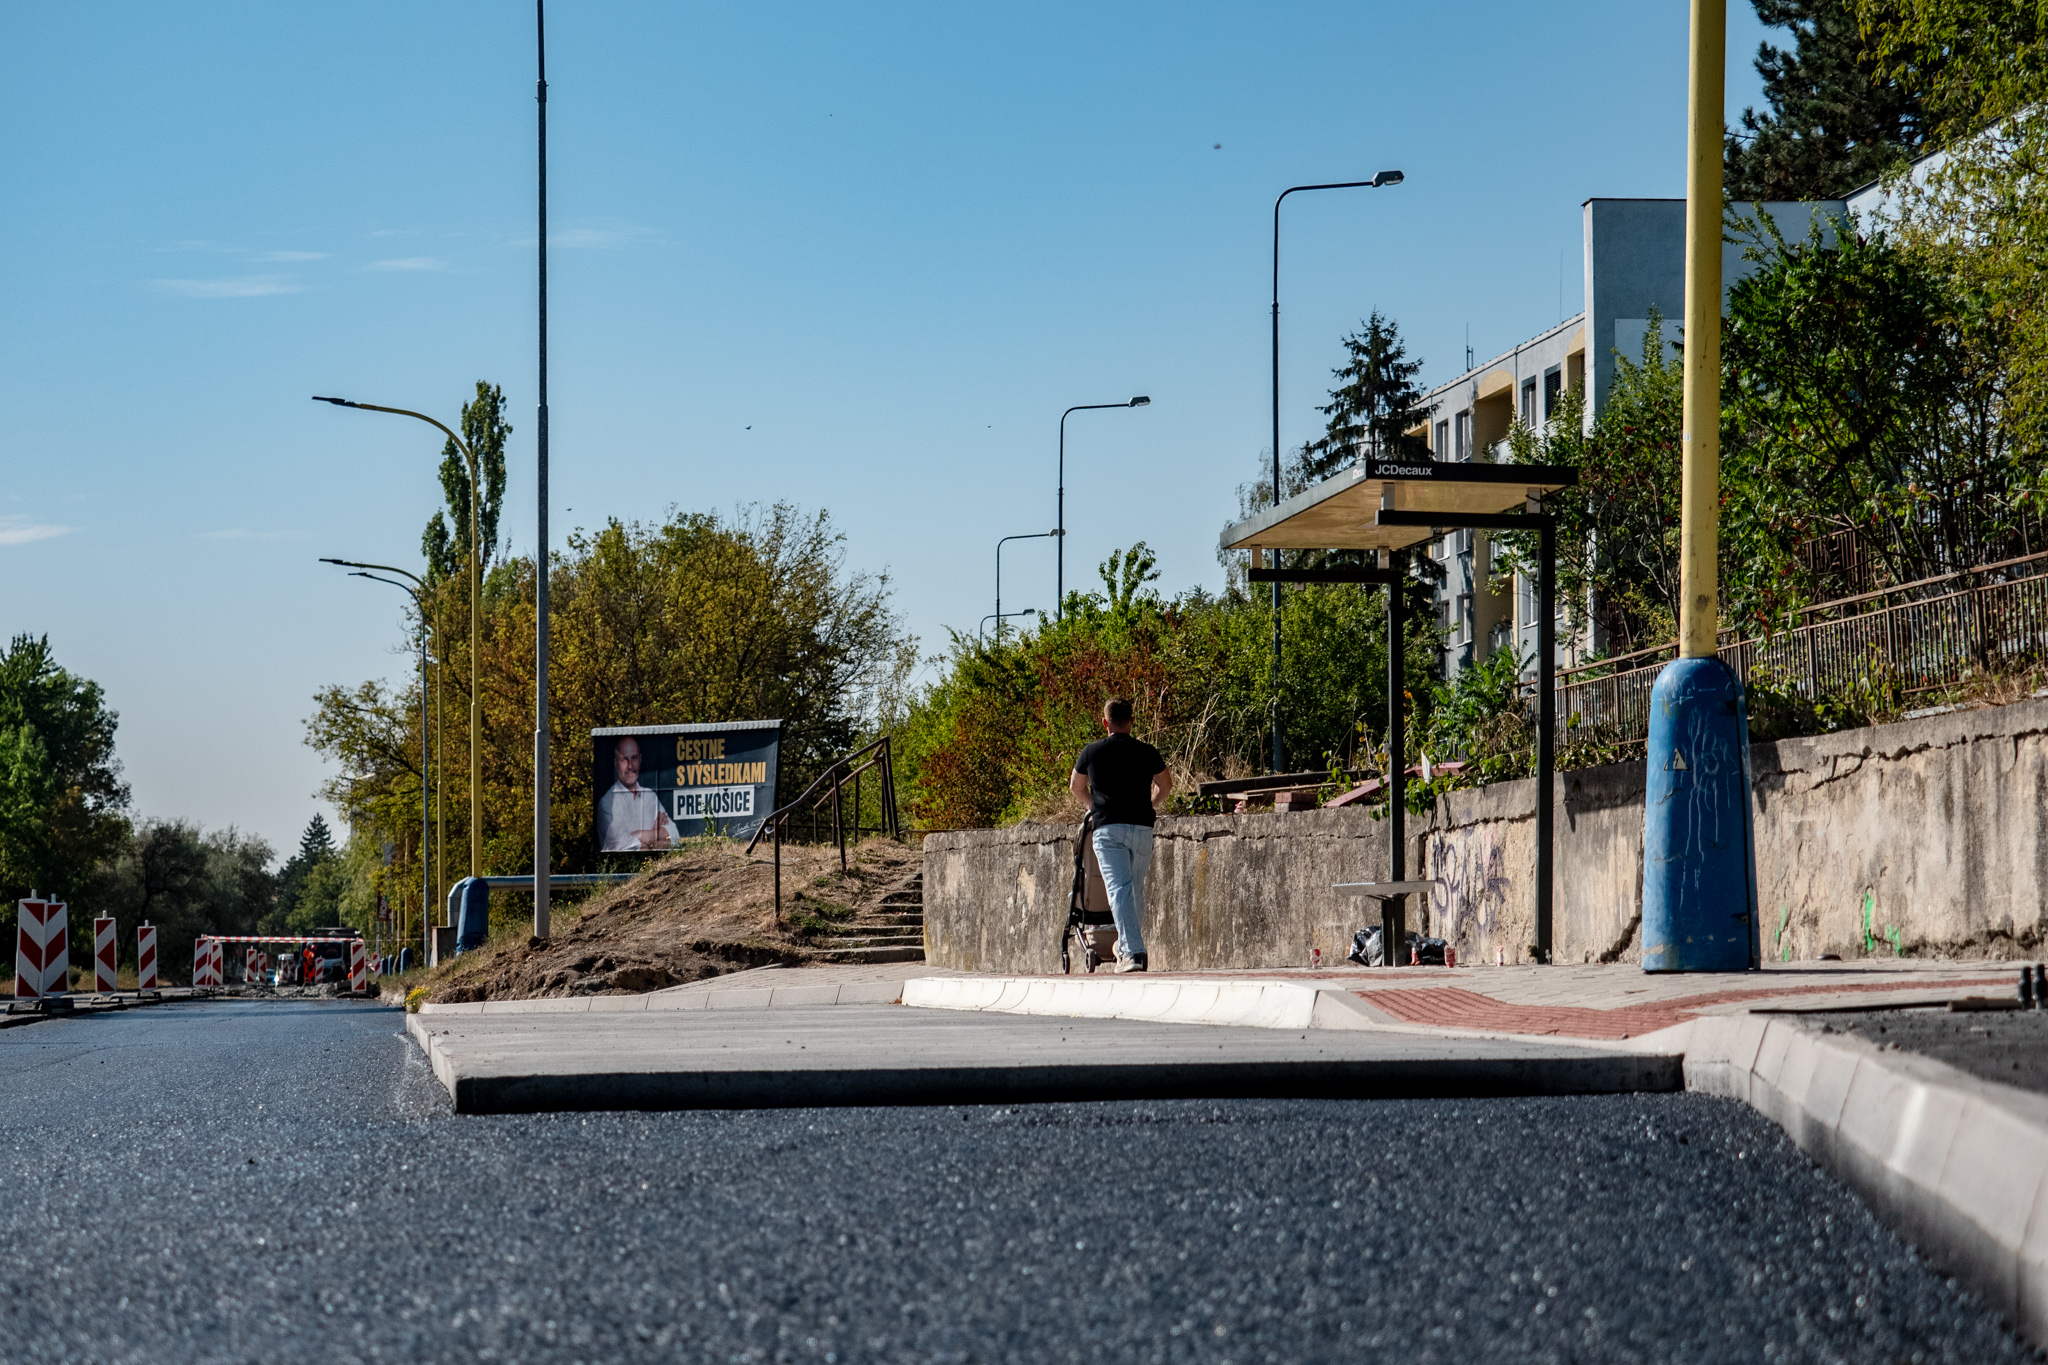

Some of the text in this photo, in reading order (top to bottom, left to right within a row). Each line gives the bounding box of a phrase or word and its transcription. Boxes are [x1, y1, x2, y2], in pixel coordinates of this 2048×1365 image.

[1374, 464, 1433, 476] JCDecaux
[676, 736, 726, 761] ČESTNE
[676, 760, 767, 787] S VÝSLEDKAMI
[677, 788, 751, 816] PRE KOŠICE
